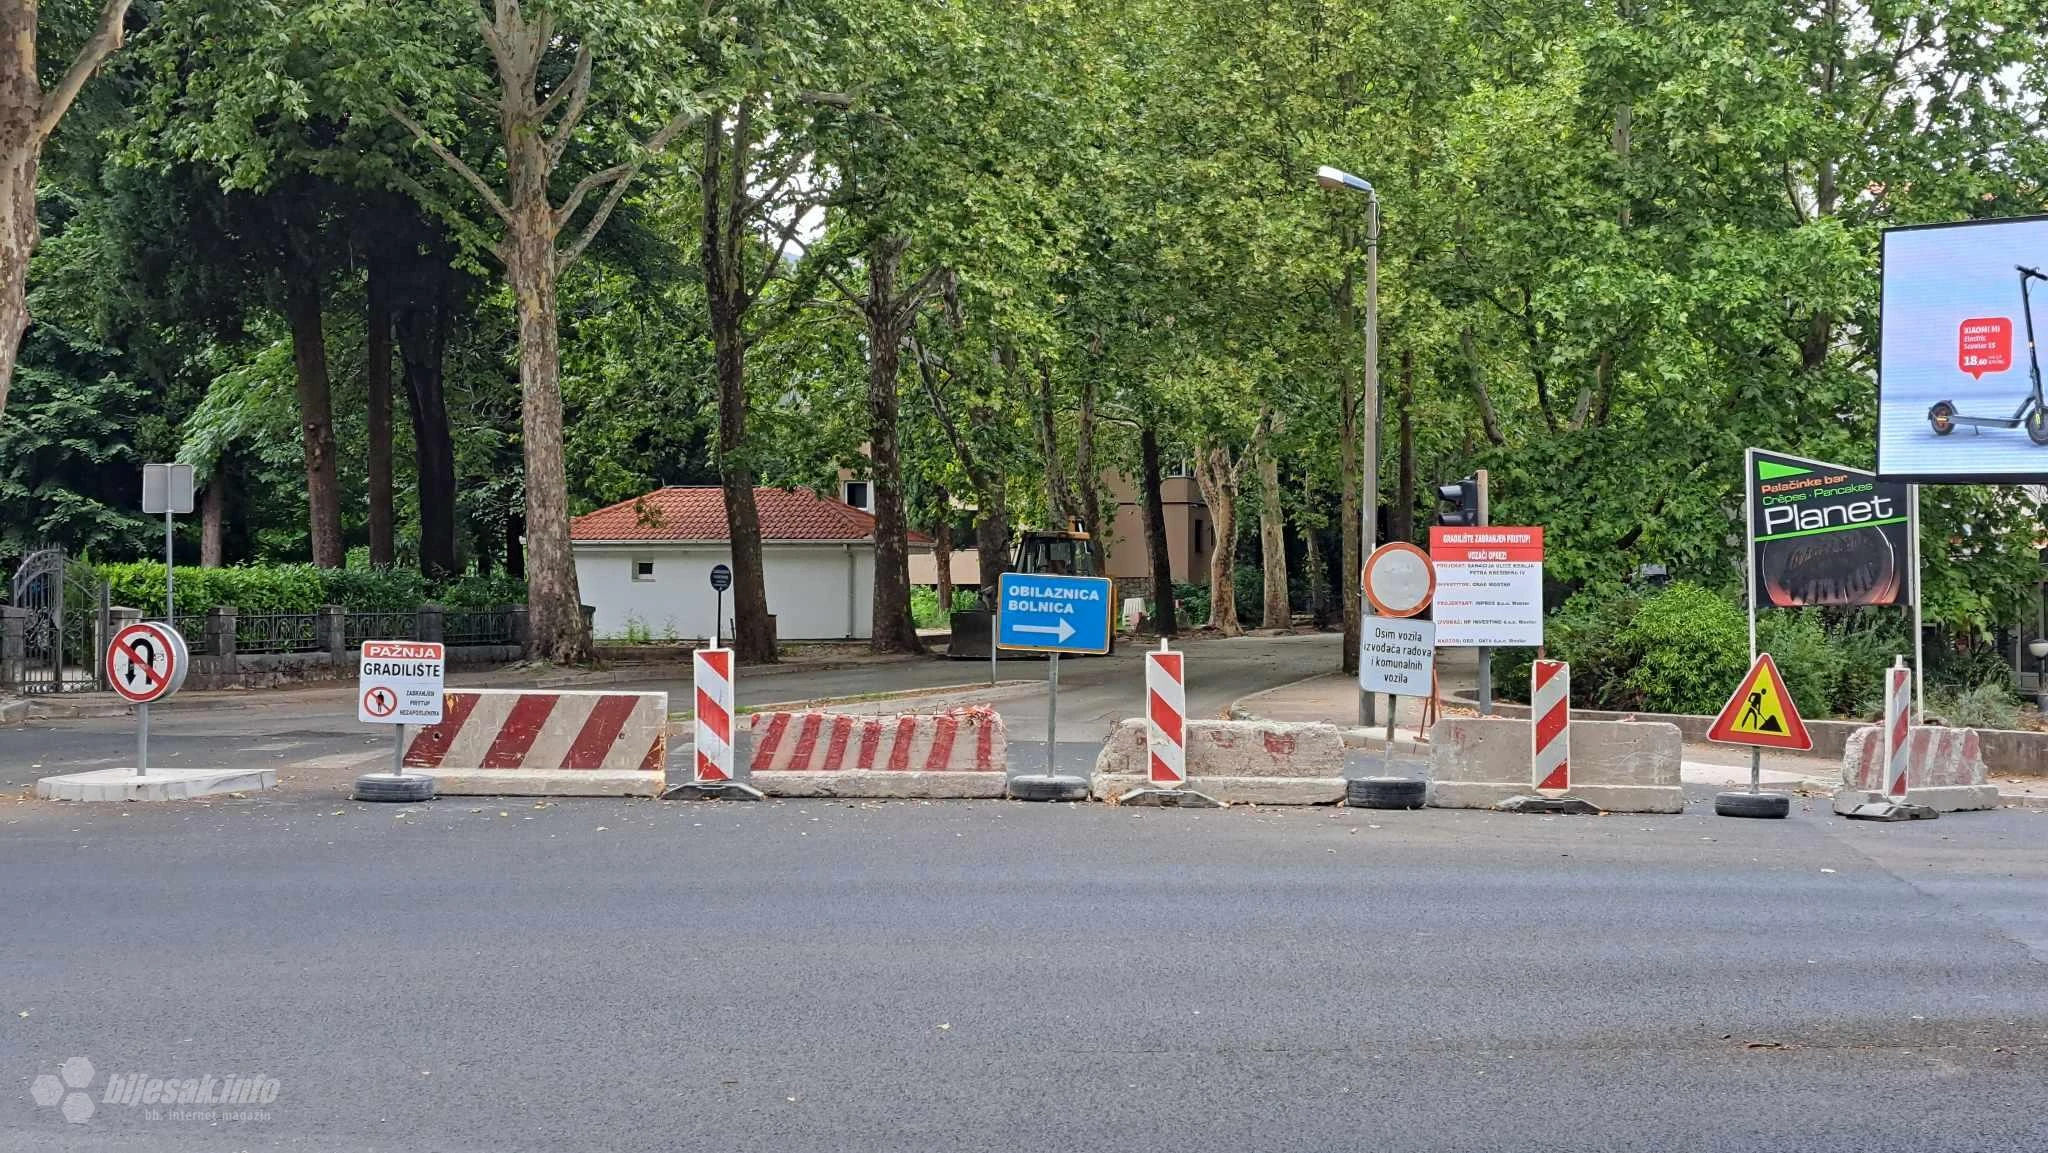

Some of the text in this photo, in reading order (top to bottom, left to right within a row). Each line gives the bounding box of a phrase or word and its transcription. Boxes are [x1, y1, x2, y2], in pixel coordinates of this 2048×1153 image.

[1761, 474, 1848, 494] Palačinke bar
[1762, 483, 1873, 506] Crêpes Pancakes
[1764, 495, 1893, 535] Planet
[1009, 585, 1099, 600] OBILAZNICA
[1008, 600, 1074, 613] BOLNICA
[1375, 627, 1422, 642] Osim vozila
[370, 645, 436, 658] PAŽNJA
[1402, 648, 1432, 657] radova
[363, 662, 440, 677] GRADILIŠTE
[1375, 656, 1423, 671] komunalnih
[1384, 673, 1408, 684] vozila
